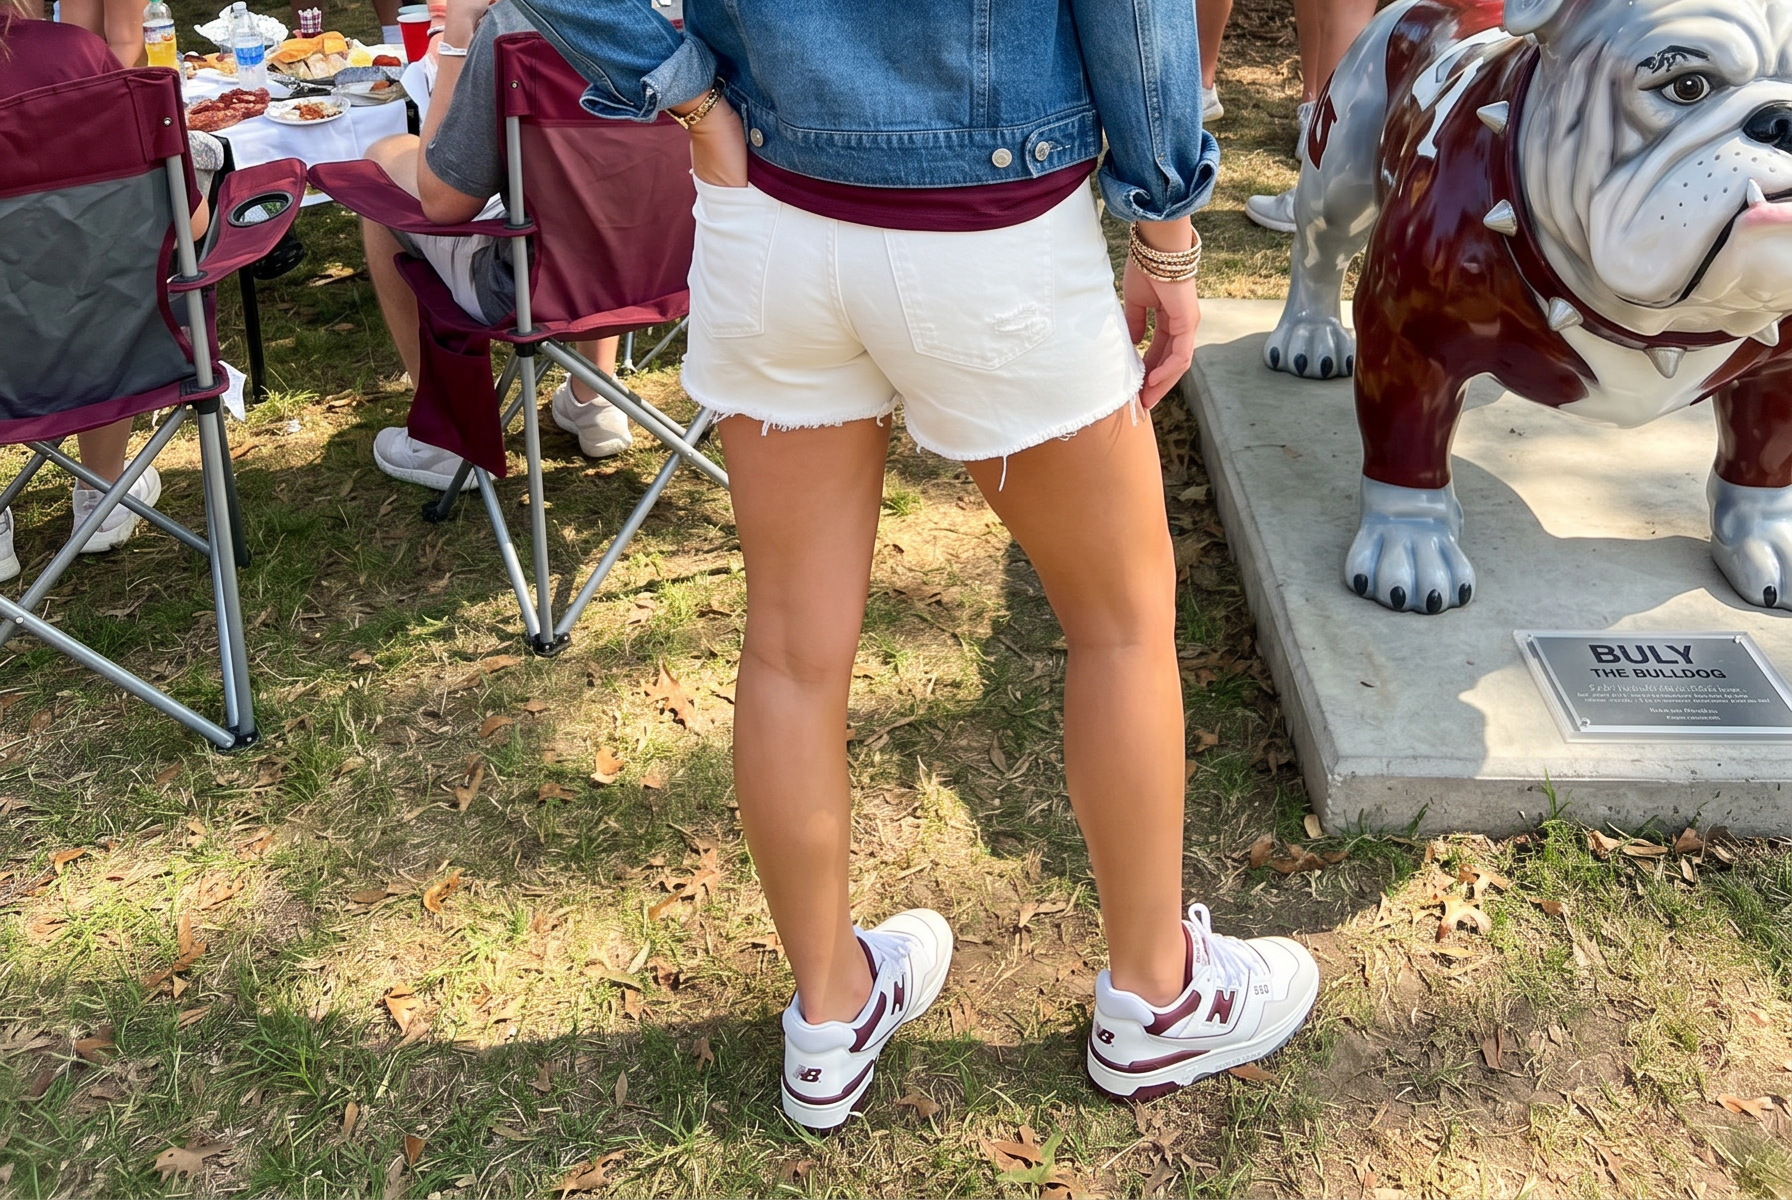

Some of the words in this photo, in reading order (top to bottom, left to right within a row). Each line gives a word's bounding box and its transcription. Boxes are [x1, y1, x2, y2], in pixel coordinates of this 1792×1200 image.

[1588, 644, 1694, 665] BULY
[1590, 668, 1630, 679] THE
[1632, 668, 1727, 679] BULLDOG
